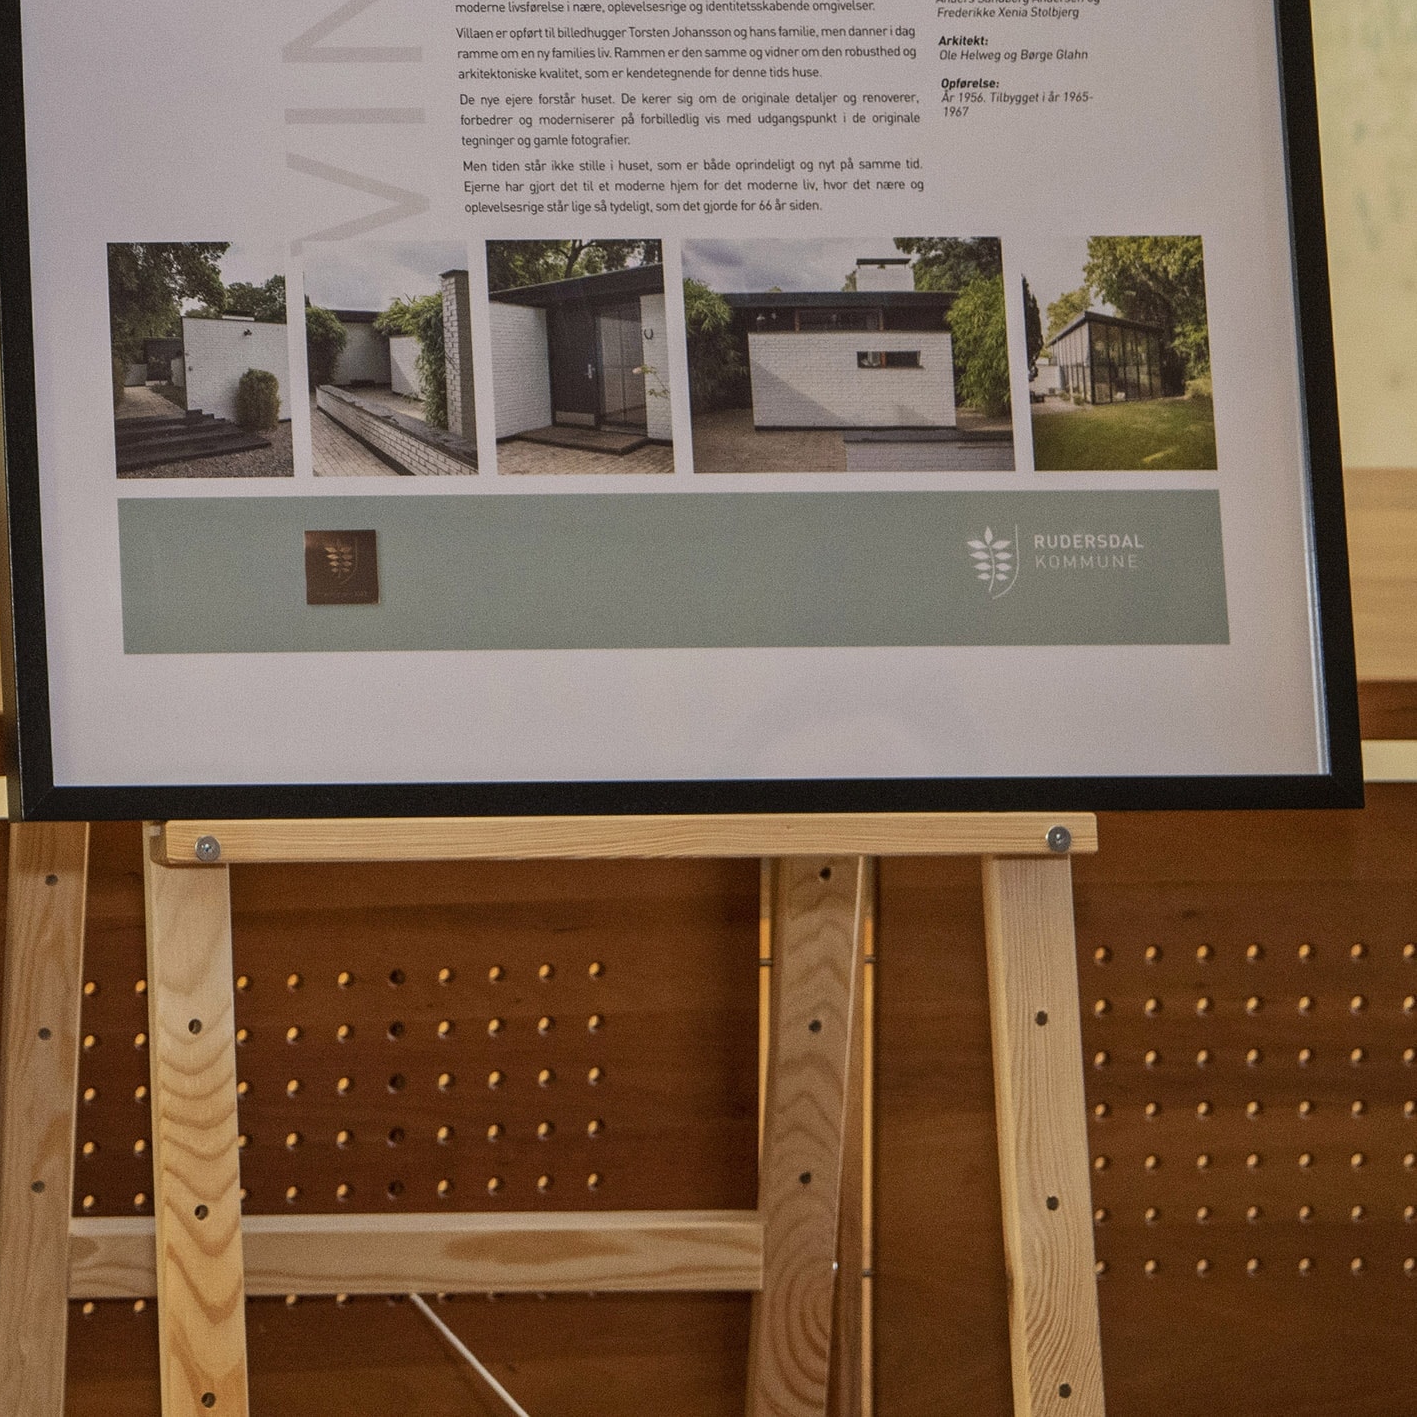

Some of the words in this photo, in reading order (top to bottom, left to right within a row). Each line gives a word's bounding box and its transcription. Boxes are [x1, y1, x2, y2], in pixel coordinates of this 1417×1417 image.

[455, 1, 506, 13] moderne
[507, 0, 564, 12] livsførelse
[572, 3, 605, 13] nære,
[607, 0, 687, 15] oplevelsesrige
[688, 2, 703, 14] og
[705, 0, 810, 11] identitetsskabende
[937, 7, 996, 17] Frederikke
[998, 7, 1028, 17] Xenia
[455, 27, 494, 38] Villaen
[495, 29, 508, 38] er
[509, 26, 543, 40] opført
[544, 26, 555, 38] til
[557, 26, 627, 41] billedhugger
[628, 25, 670, 38] Torsten
[672, 26, 732, 37] Johansson
[733, 28, 747, 40] og
[748, 25, 777, 37] hans
[777, 25, 819, 38] familie,
[820, 27, 846, 37] men
[847, 25, 888, 36] danner
[894, 25, 915, 39] dag
[938, 35, 989, 46] Arkitekt:
[939, 49, 957, 61] Ole
[960, 49, 1001, 62] Helweg
[1004, 52, 1017, 62] og
[1020, 49, 1053, 62] Børge
[1056, 48, 1088, 60] Glahn
[457, 67, 537, 79] arkitektoniske
[538, 67, 582, 79] kvalitet,
[584, 69, 609, 78] som
[611, 69, 624, 78] er
[625, 66, 711, 81] kendetegnende
[713, 66, 730, 78] for
[731, 66, 767, 78] denne
[768, 66, 790, 77] tids
[791, 66, 822, 77] huse.
[941, 78, 1000, 90] Opførelse:
[459, 93, 475, 105] De
[480, 96, 500, 107] nye
[505, 93, 533, 107] ejere
[538, 91, 576, 104] forstår
[580, 93, 615, 104] huset.
[620, 92, 636, 104] De
[641, 92, 672, 104] kerer
[676, 92, 693, 107] sig
[698, 95, 717, 104] om
[722, 92, 736, 103] de
[741, 92, 790, 106] originale
[794, 91, 838, 106] detaljer
[842, 94, 857, 106] og
[941, 89, 955, 103] År
[959, 91, 986, 103] 1956.
[990, 91, 1039, 105] Tilbygget
[1048, 90, 1060, 102] år
[1063, 91, 1094, 102] 1965-
[943, 106, 969, 117] 1967
[460, 113, 513, 125] forbedrer
[518, 116, 533, 128] og
[538, 113, 615, 125] moderniserer
[620, 111, 635, 127] på
[704, 112, 720, 124] vis
[726, 112, 751, 124] med
[757, 112, 837, 127] udgangspunkt
[851, 112, 866, 123] de
[871, 111, 920, 126] originale
[462, 160, 487, 172] Men
[491, 160, 520, 171] tiden
[524, 158, 547, 171] står
[551, 159, 574, 171] ikke
[578, 159, 606, 171] stille
[618, 159, 652, 172] huset,
[656, 161, 682, 171] som
[686, 161, 699, 170] er
[703, 157, 731, 170] både
[735, 158, 795, 173] oprindeligt
[799, 160, 814, 173] og
[818, 159, 835, 172] nyt
[839, 156, 854, 172] på
[858, 160, 901, 169] samme
[905, 157, 922, 169] tid.
[464, 200, 544, 216] oplevelsesrige
[546, 199, 569, 212] står
[571, 200, 591, 215] lige
[593, 198, 607, 212] så
[609, 200, 653, 215] tydeligt,
[655, 202, 680, 211] som
[682, 200, 700, 211] det
[702, 199, 738, 214] gjorde
[740, 199, 756, 211] for
[758, 199, 772, 211] 66
[774, 197, 786, 211] år
[788, 198, 822, 211] siden.
[1033, 534, 1145, 549] RUDERSDAL
[1035, 554, 1139, 569] KOMMUNE
